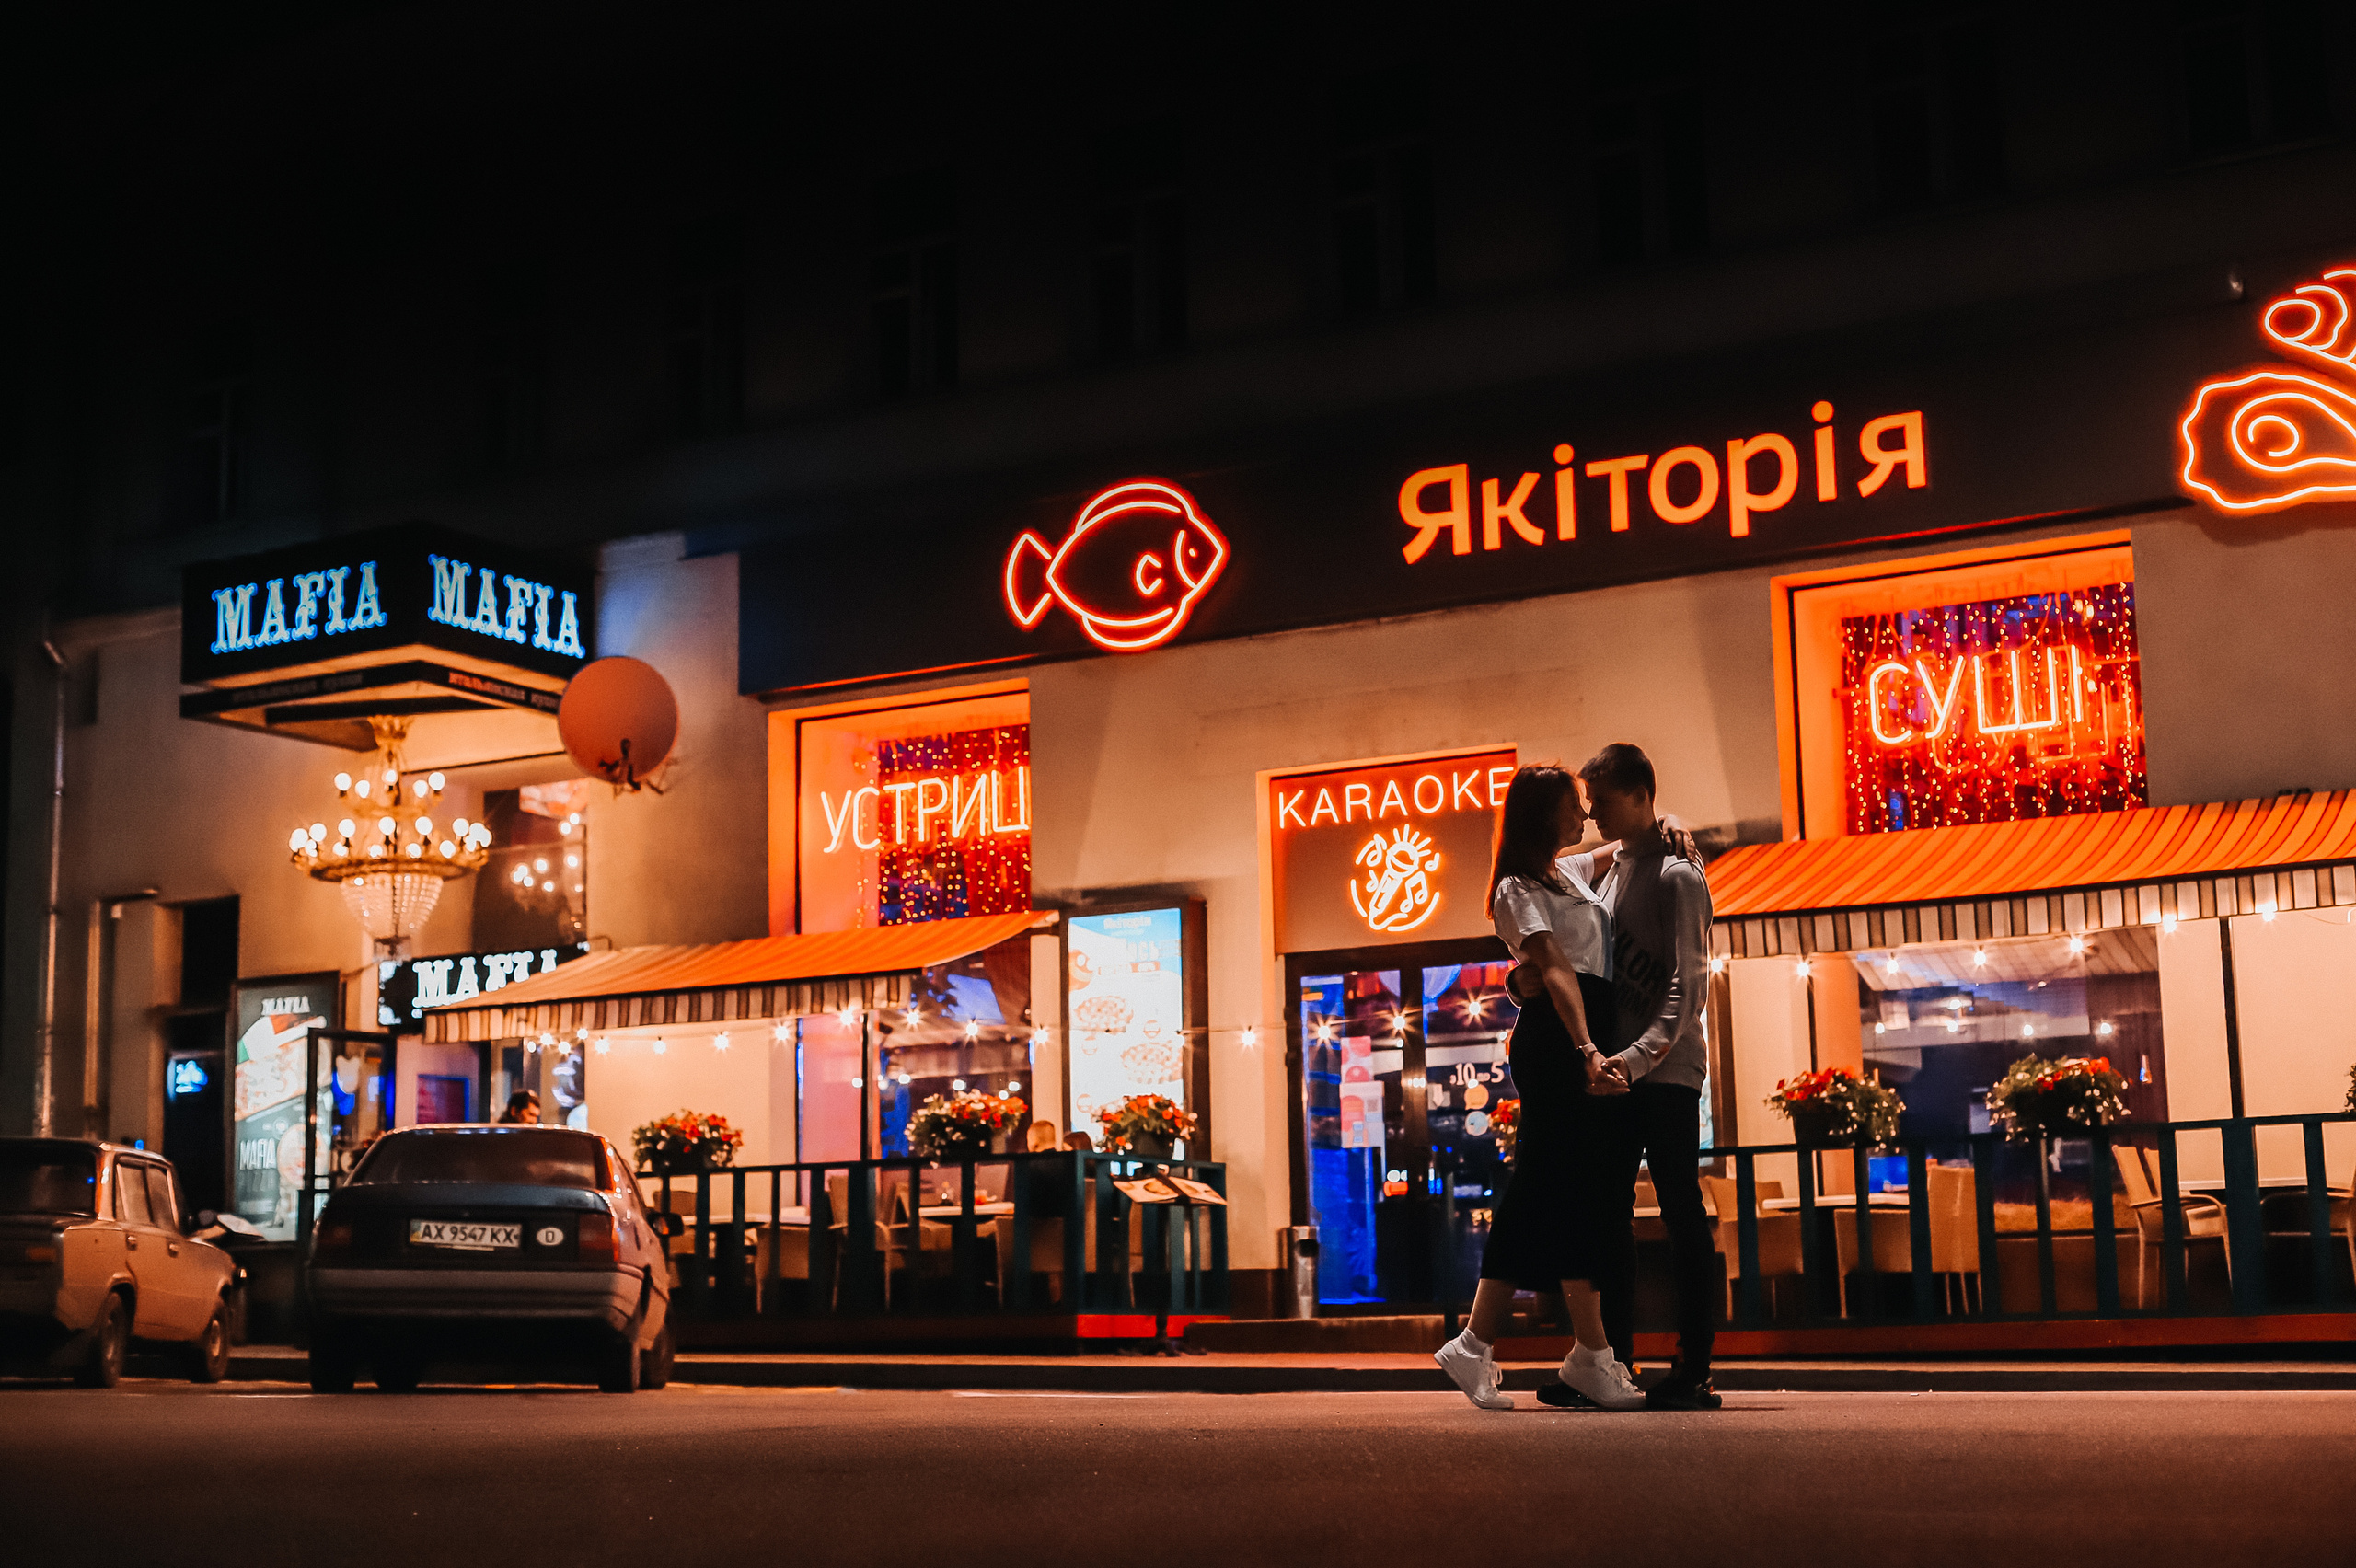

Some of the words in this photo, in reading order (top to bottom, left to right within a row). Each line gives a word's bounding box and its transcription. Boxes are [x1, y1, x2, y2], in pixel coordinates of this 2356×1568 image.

[1398, 400, 1926, 565] Якіторія
[211, 561, 387, 654] MAFIA
[428, 554, 585, 659] MAFIA
[1869, 644, 2082, 744] СУШІ
[821, 766, 1030, 853] УСТРИЦ
[1278, 767, 1514, 829] KARAOKE
[422, 1224, 445, 1240] AX
[449, 1226, 487, 1242] 9547
